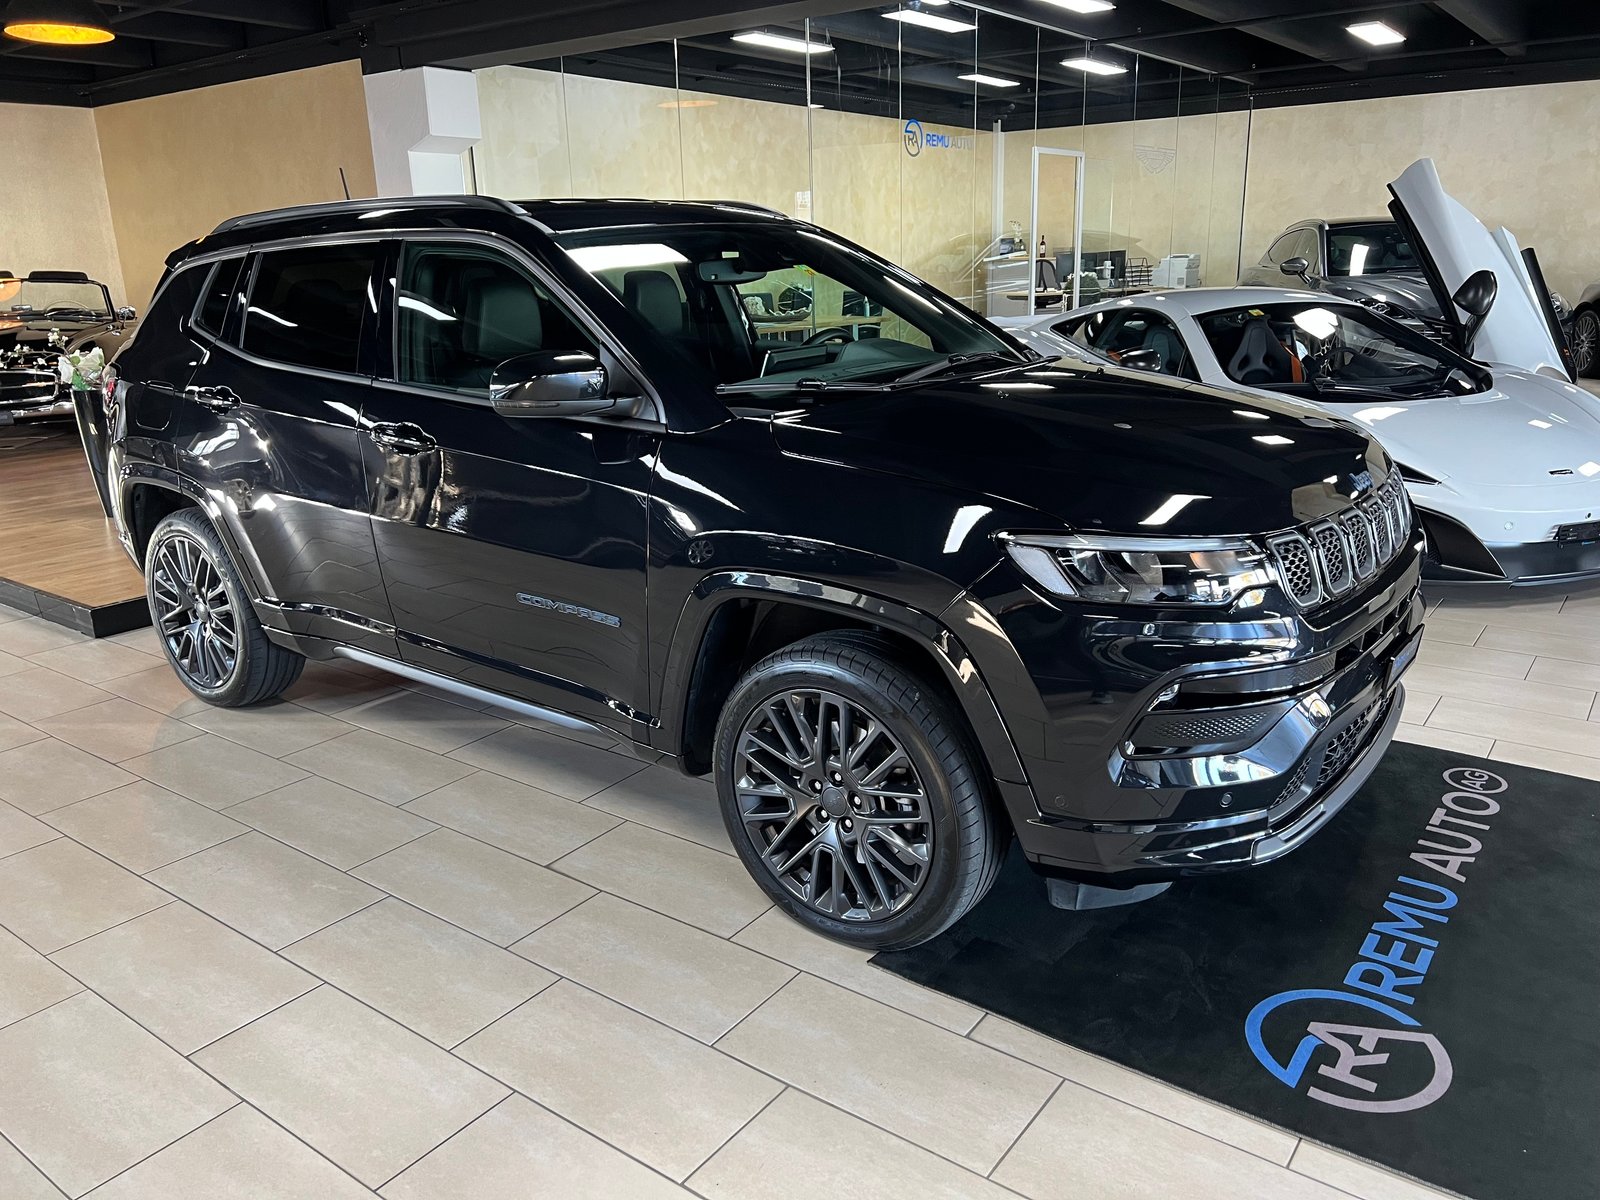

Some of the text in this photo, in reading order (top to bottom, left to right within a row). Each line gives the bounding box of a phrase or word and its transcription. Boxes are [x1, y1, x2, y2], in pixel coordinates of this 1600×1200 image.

[926, 133, 949, 148] REMU
[516, 592, 621, 628] COMPASS
[1343, 875, 1458, 1005] REMU
[1409, 791, 1501, 883] AUTO
[1460, 770, 1489, 791] AG
